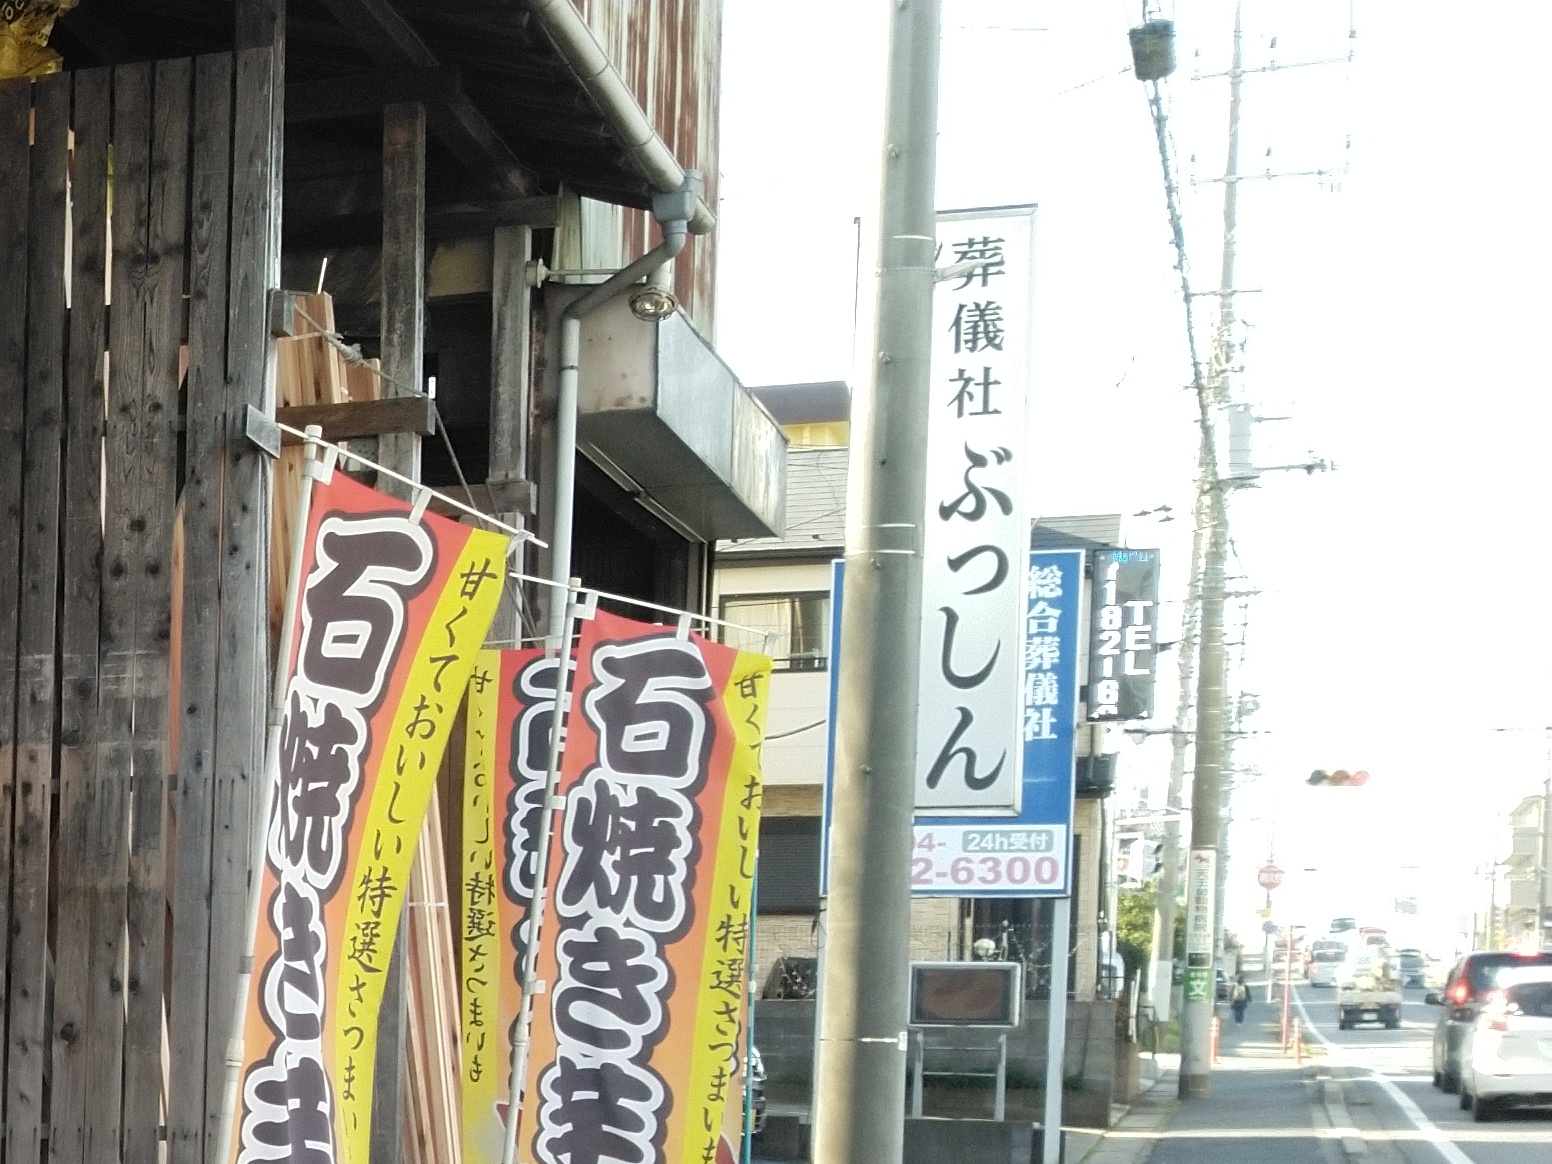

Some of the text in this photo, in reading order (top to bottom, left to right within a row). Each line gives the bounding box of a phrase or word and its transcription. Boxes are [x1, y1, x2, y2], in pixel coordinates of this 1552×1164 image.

[926, 441, 1013, 792] ぶつしん
[1023, 564, 1064, 742] 総合葬儀社
[1124, 600, 1154, 676] TEL
[913, 832, 946, 852] 4-
[967, 832, 1048, 851] 24h受付
